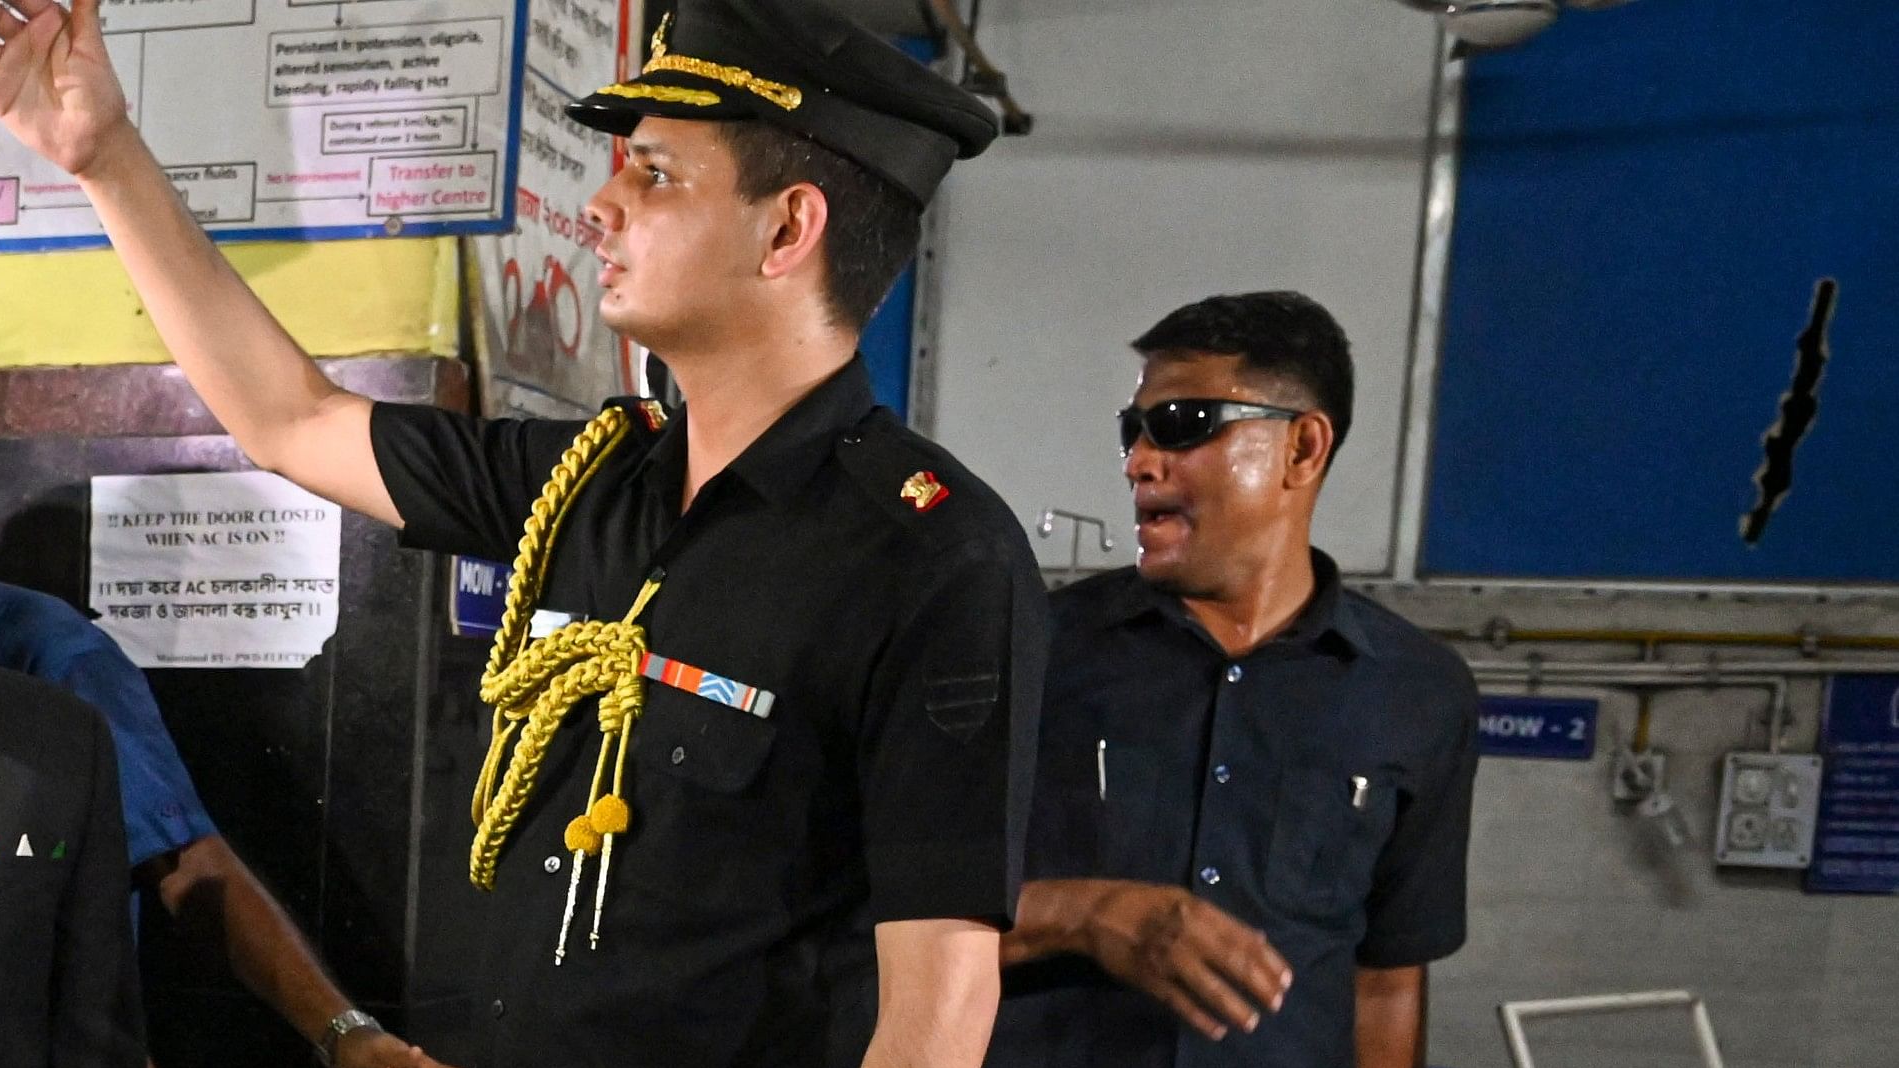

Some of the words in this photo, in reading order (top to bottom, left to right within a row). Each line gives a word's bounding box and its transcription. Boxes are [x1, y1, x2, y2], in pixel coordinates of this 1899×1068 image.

[402, 56, 440, 69] active
[335, 80, 380, 95] rapidly
[384, 76, 423, 91] falling
[330, 121, 361, 132] During
[328, 136, 378, 146] continued
[381, 135, 401, 143] over
[203, 167, 237, 180] fluids
[390, 163, 453, 181] Transfer
[458, 163, 476, 178] to
[375, 190, 427, 210] higher
[432, 189, 487, 206] Centre
[123, 512, 166, 527] KEEP
[170, 511, 199, 526] THE
[207, 511, 254, 525] DOOR
[259, 509, 325, 523] CLOSED
[145, 533, 196, 546] WHEN
[202, 532, 220, 545] AC
[228, 531, 242, 545] IS
[246, 530, 271, 544] ON
[146, 580, 181, 595] করে
[185, 581, 206, 595] AC
[210, 573, 287, 595] চলাকালীন
[460, 560, 495, 596] MOW
[108, 604, 152, 619] দরজা
[156, 603, 168, 619] ও
[171, 603, 227, 618] জানালা
[232, 602, 257, 619] বন্ধ
[261, 602, 302, 620] রাখুন
[1568, 717, 1585, 740] 2
